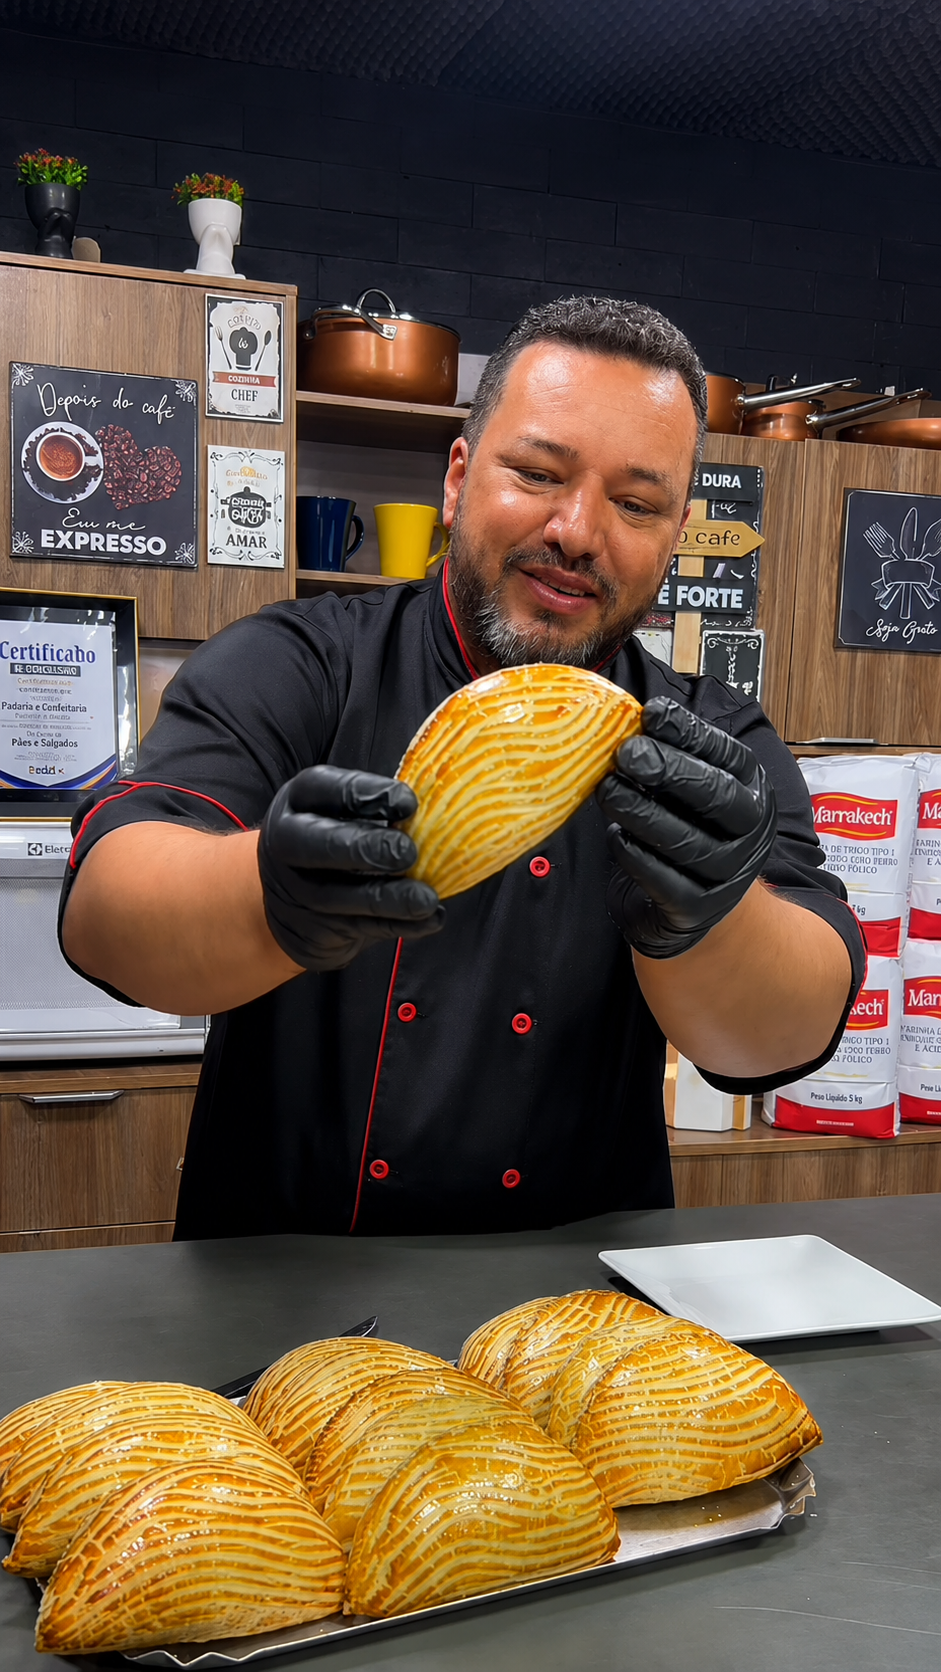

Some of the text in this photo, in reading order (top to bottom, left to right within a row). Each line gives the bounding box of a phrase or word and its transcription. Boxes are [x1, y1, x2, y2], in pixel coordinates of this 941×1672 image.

[231, 389, 258, 402] CHEF
[37, 382, 176, 425] Depois do café
[702, 474, 742, 489] DURA
[105, 518, 146, 531] me
[41, 529, 167, 556] EXPRESSO
[225, 534, 267, 549] AMAR
[676, 585, 744, 609] FORTE
[1, 701, 33, 711] Padaria
[42, 702, 87, 713] Confeitaria
[812, 806, 893, 826] Marrakech
[811, 1092, 825, 1101] Peso
[855, 1095, 862, 1104] kg
